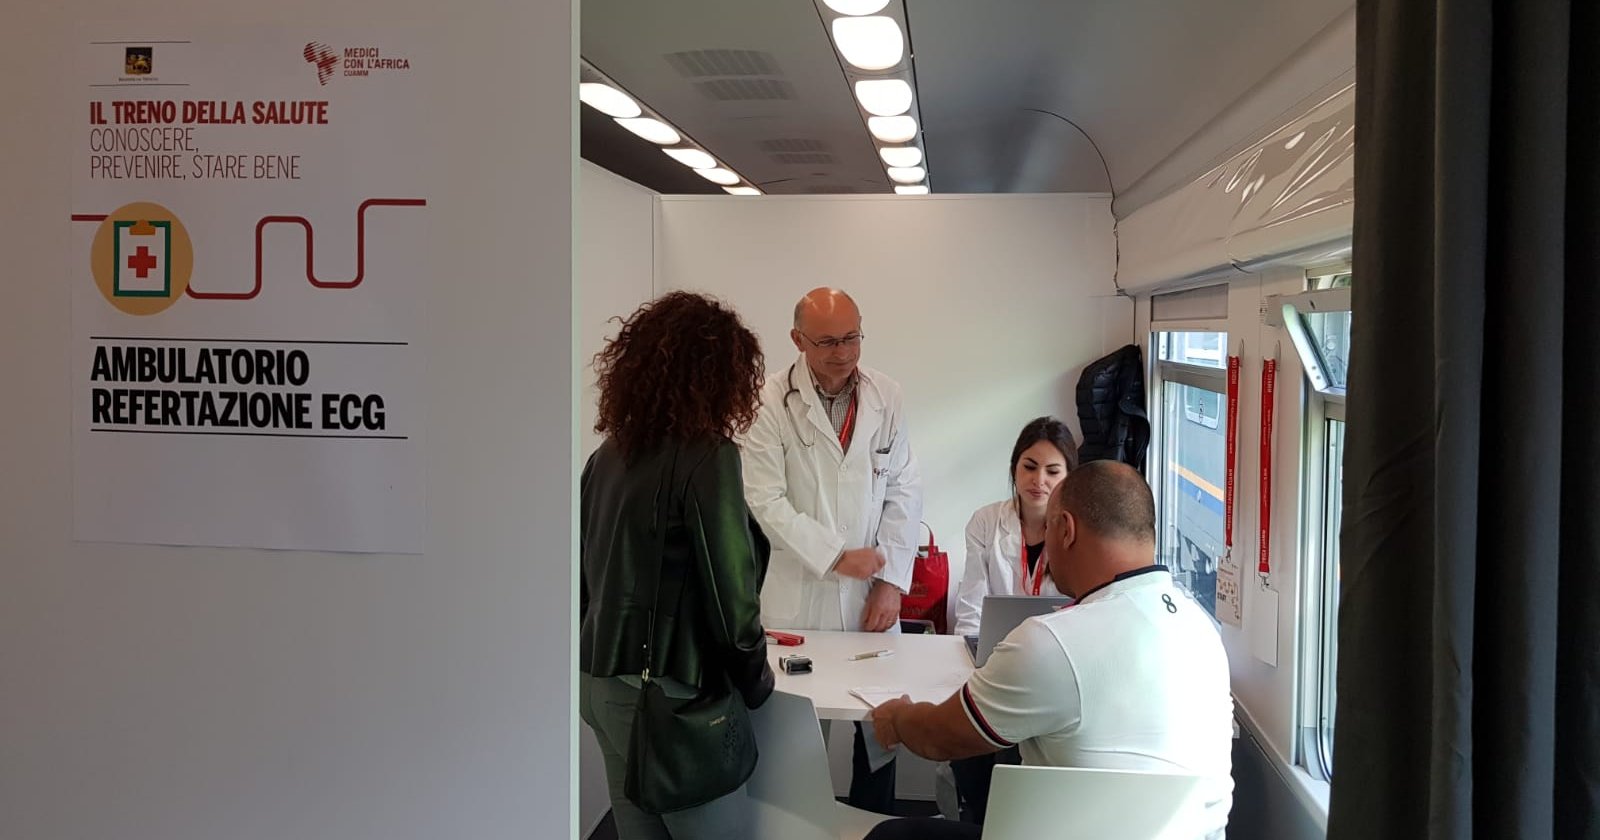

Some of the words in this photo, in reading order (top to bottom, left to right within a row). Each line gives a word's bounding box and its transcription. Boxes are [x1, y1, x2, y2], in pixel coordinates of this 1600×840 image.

[344, 47, 379, 58] MEDICI
[344, 58, 364, 69] CON
[367, 58, 410, 69] L'AFRICA
[90, 101, 107, 125] IL
[112, 101, 176, 125] TRENO
[182, 101, 246, 124] DELLA
[252, 101, 328, 124] SALUTE
[90, 127, 199, 153] CONOSCERE,
[90, 155, 187, 180] PREVENIRE,
[192, 154, 248, 179] STARE
[254, 155, 301, 180] BENE
[90, 346, 309, 386] AMBULATORIO
[91, 388, 312, 429] REFERTAZIONE
[322, 394, 386, 430] ECG
